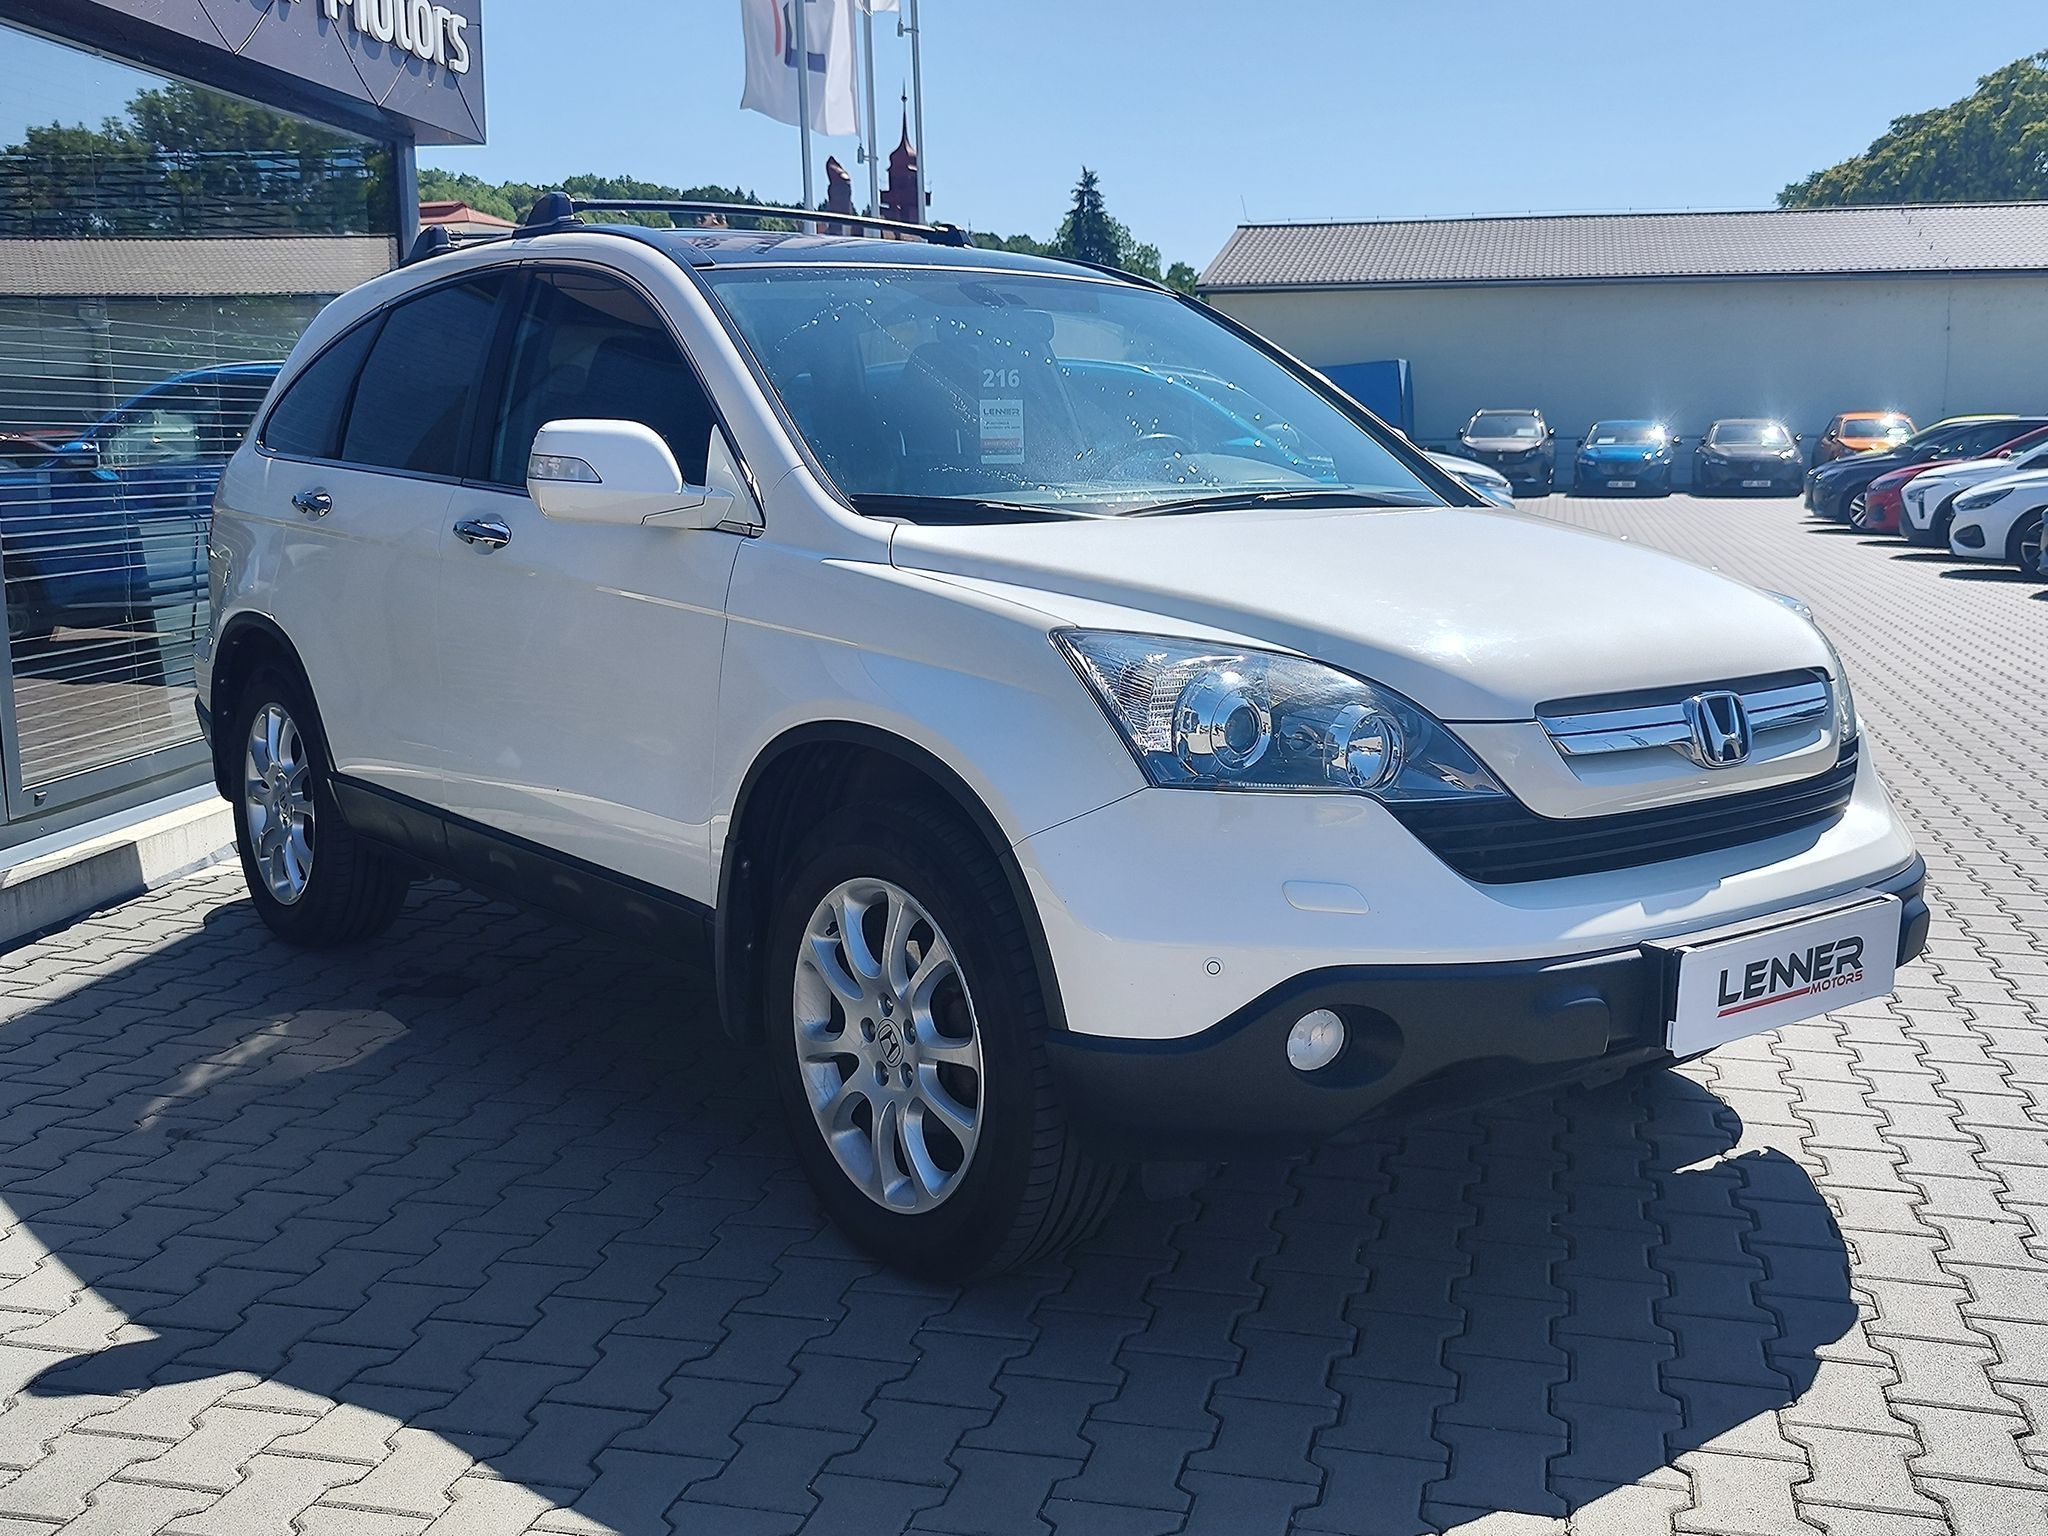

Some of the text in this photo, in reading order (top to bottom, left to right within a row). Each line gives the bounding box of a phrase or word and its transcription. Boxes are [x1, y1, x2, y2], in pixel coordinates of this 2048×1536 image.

[982, 368, 1021, 388] 216
[1717, 935, 1864, 1007] LENNER
[1809, 969, 1863, 995] MOTORS
